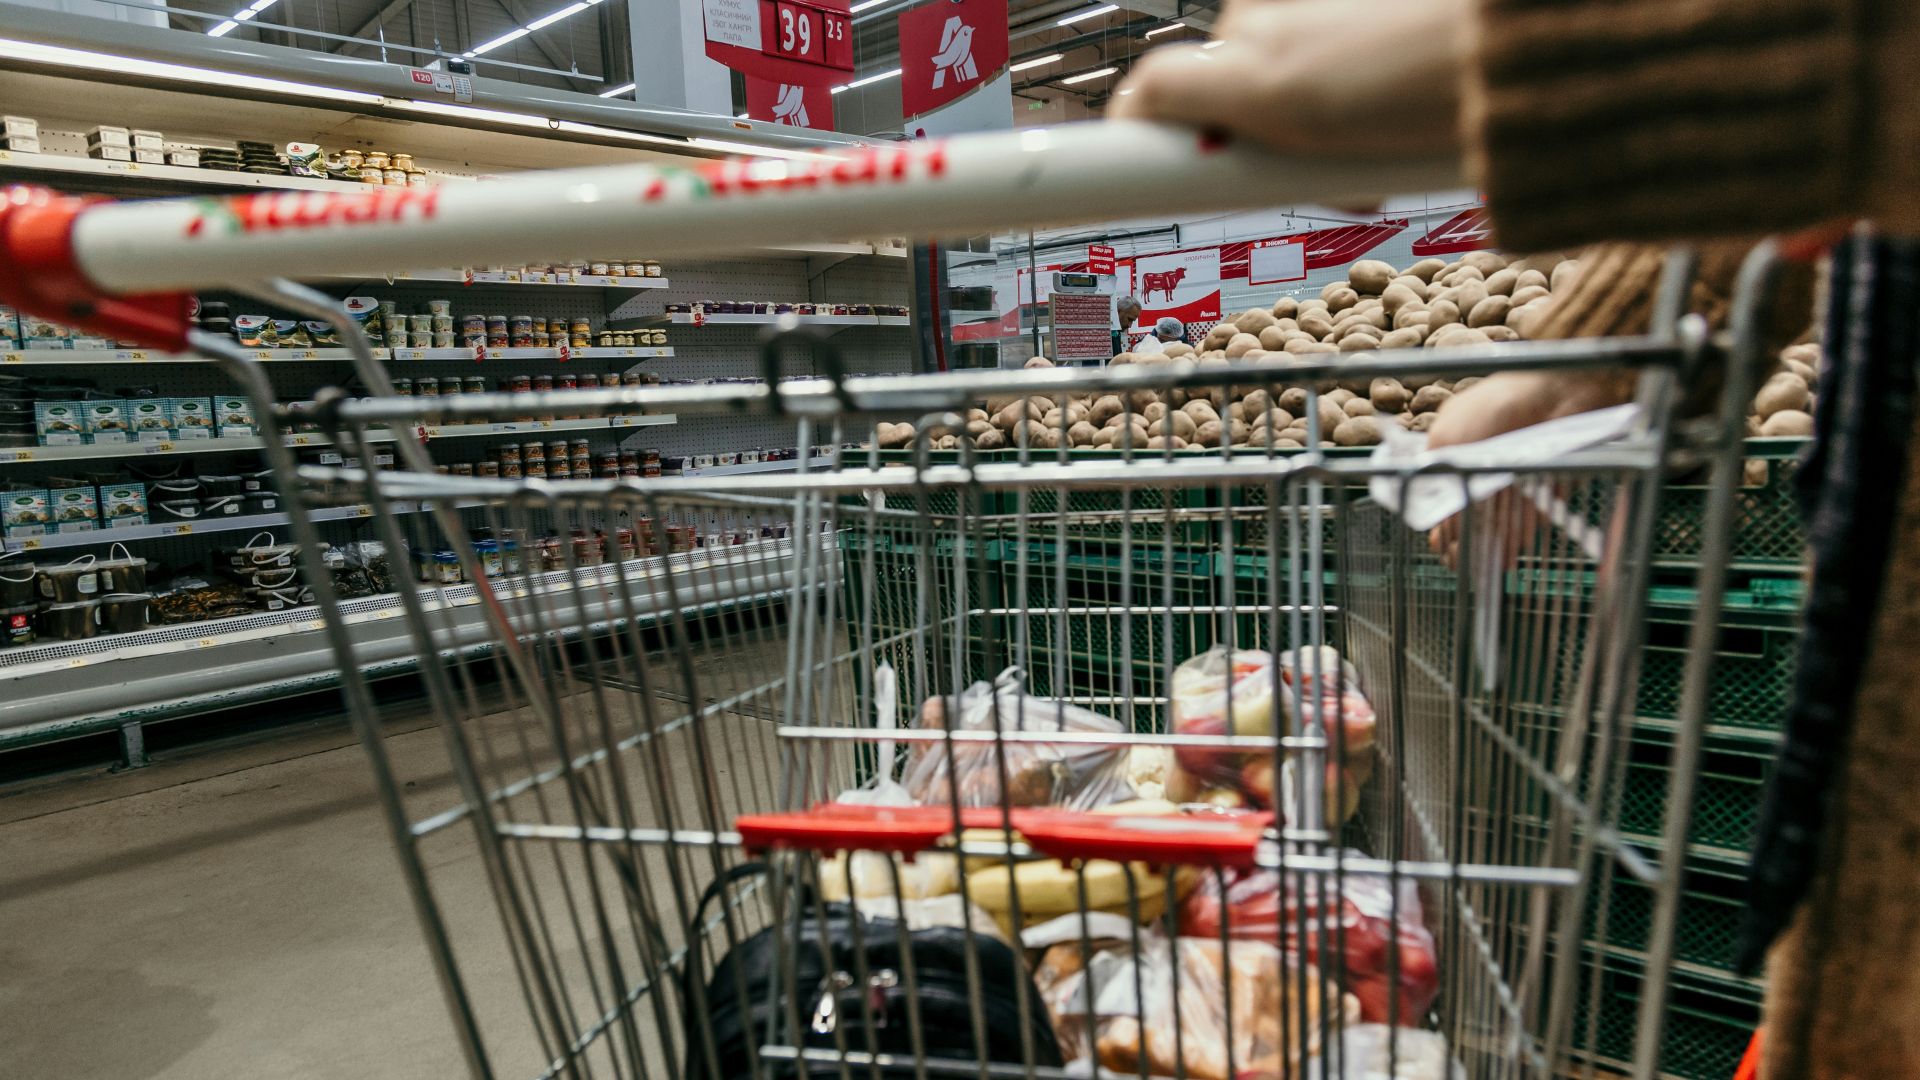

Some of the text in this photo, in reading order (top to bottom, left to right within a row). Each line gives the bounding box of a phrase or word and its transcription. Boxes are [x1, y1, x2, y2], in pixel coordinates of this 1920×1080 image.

[723, 32, 743, 42] ПАПА
[781, 9, 843, 55] 39 25
[415, 73, 431, 82] 120
